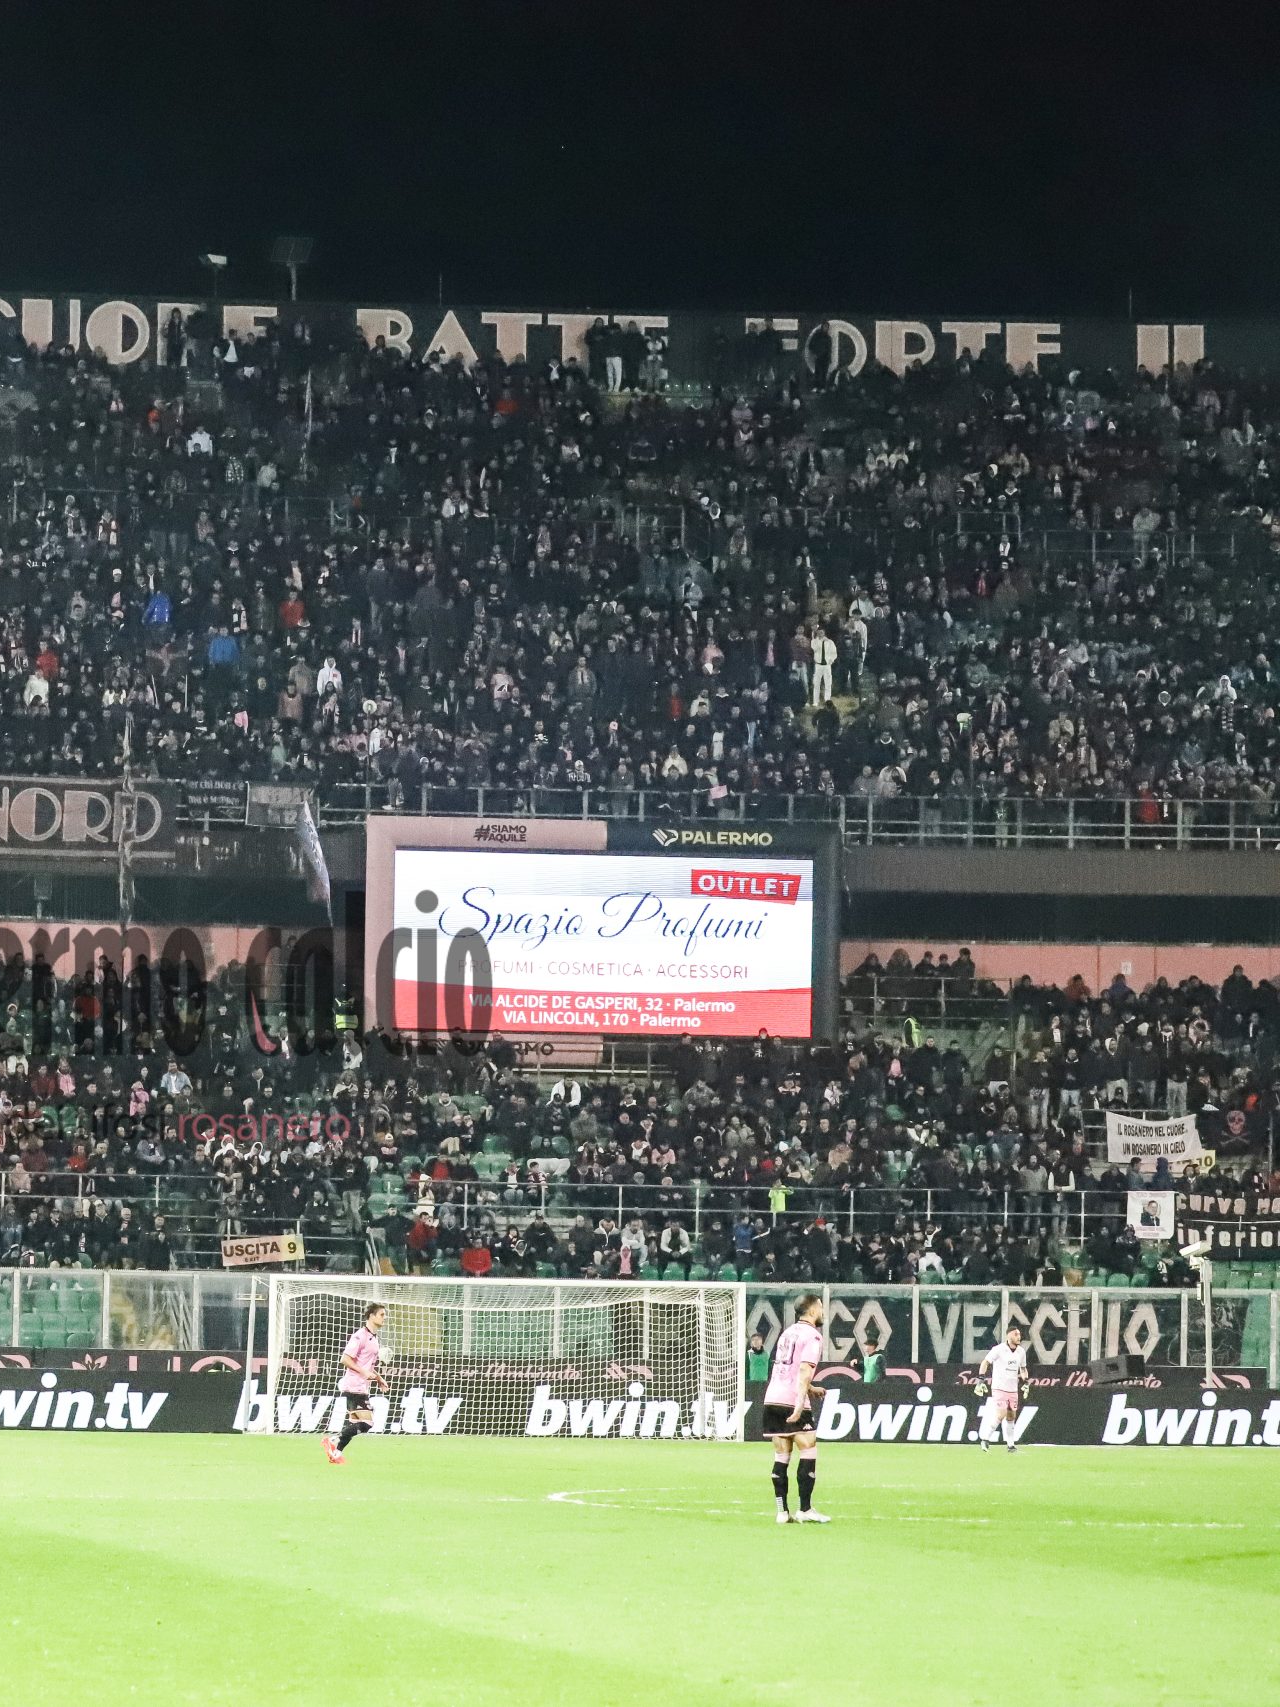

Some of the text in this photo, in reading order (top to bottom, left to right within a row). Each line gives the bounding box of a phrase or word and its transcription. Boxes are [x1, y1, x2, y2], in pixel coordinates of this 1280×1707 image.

[488, 833, 527, 843] AQUILE
[682, 830, 773, 847] PALERMO
[697, 873, 795, 898] OUTLET
[438, 886, 770, 957] Spazio Profumi
[458, 959, 749, 980] PROFUMI COSMETICA ACCESSORI
[495, 994, 549, 1008] ALCIDE
[552, 995, 573, 1008] DE
[575, 996, 641, 1012] GASPERI,
[645, 997, 663, 1012] 32
[674, 998, 735, 1013] Palermo
[503, 1010, 701, 1028] VIA LINCOLN, 170 Palermo
[1123, 1124, 1153, 1137] ROSANERO
[1154, 1126, 1166, 1138] NEL
[1122, 1140, 1186, 1156] UN ROSANERO IN CIELO
[1177, 1222, 1280, 1248] inferio
[223, 1241, 297, 1258] USCITA 9
[921, 1300, 1161, 1365] VECCHIO
[525, 1381, 753, 1438] bwin.tv
